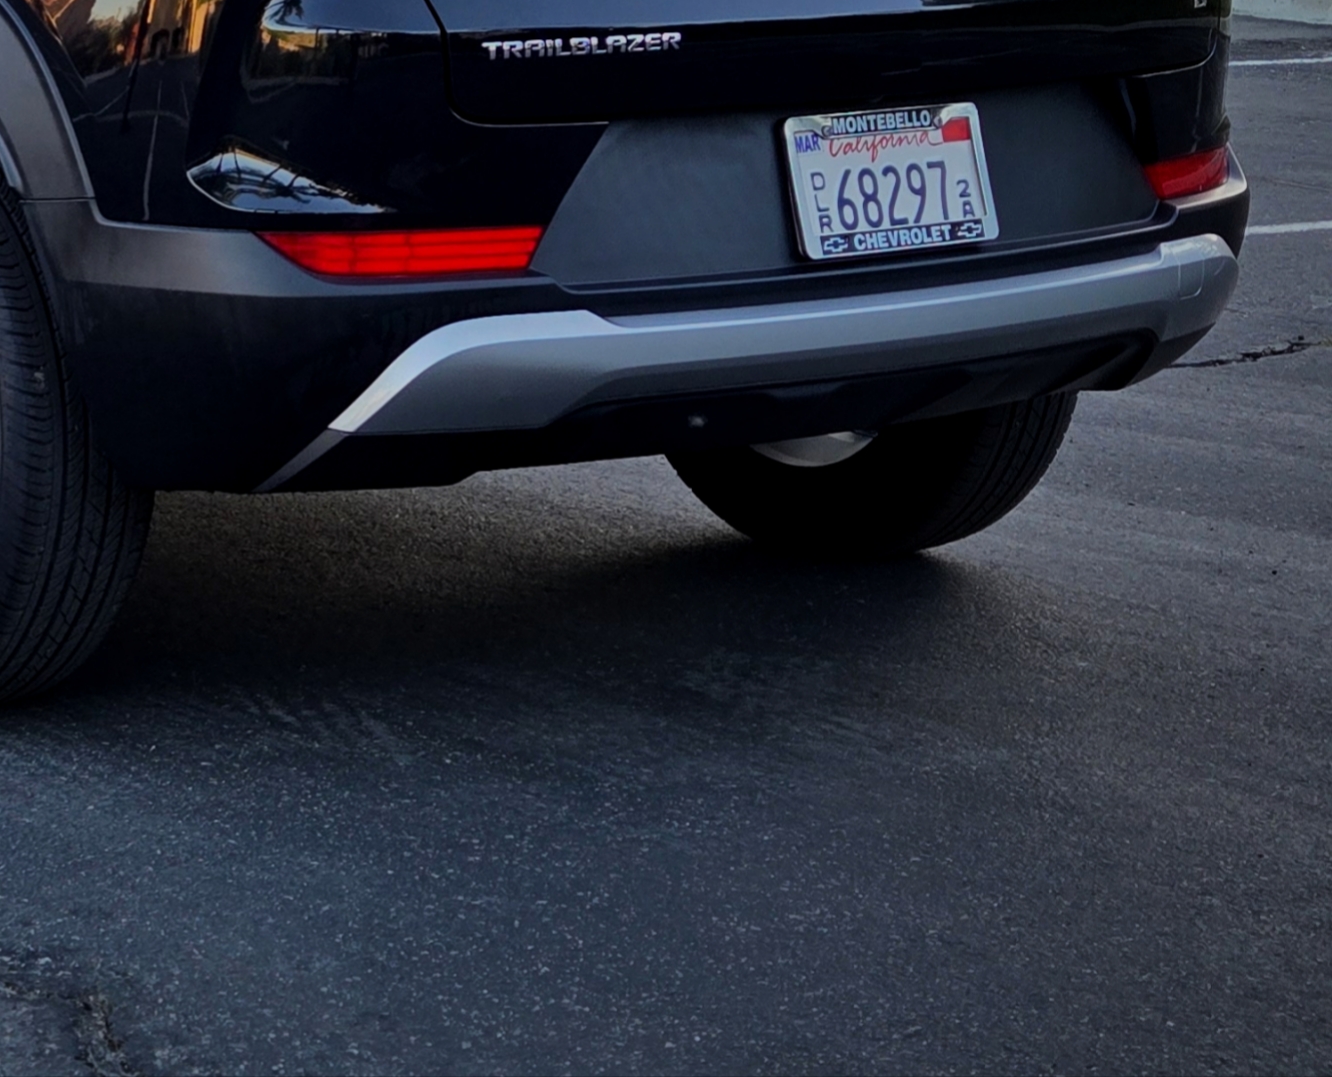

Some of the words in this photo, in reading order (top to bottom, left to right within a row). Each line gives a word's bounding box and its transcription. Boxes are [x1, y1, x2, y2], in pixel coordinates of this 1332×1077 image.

[481, 32, 682, 60] TRAILBLAZER
[832, 109, 931, 135] MONTEBELLO
[794, 132, 821, 154] MAR
[828, 130, 943, 163] California
[837, 160, 949, 231] 68297
[853, 224, 953, 251] CHEVROLET
